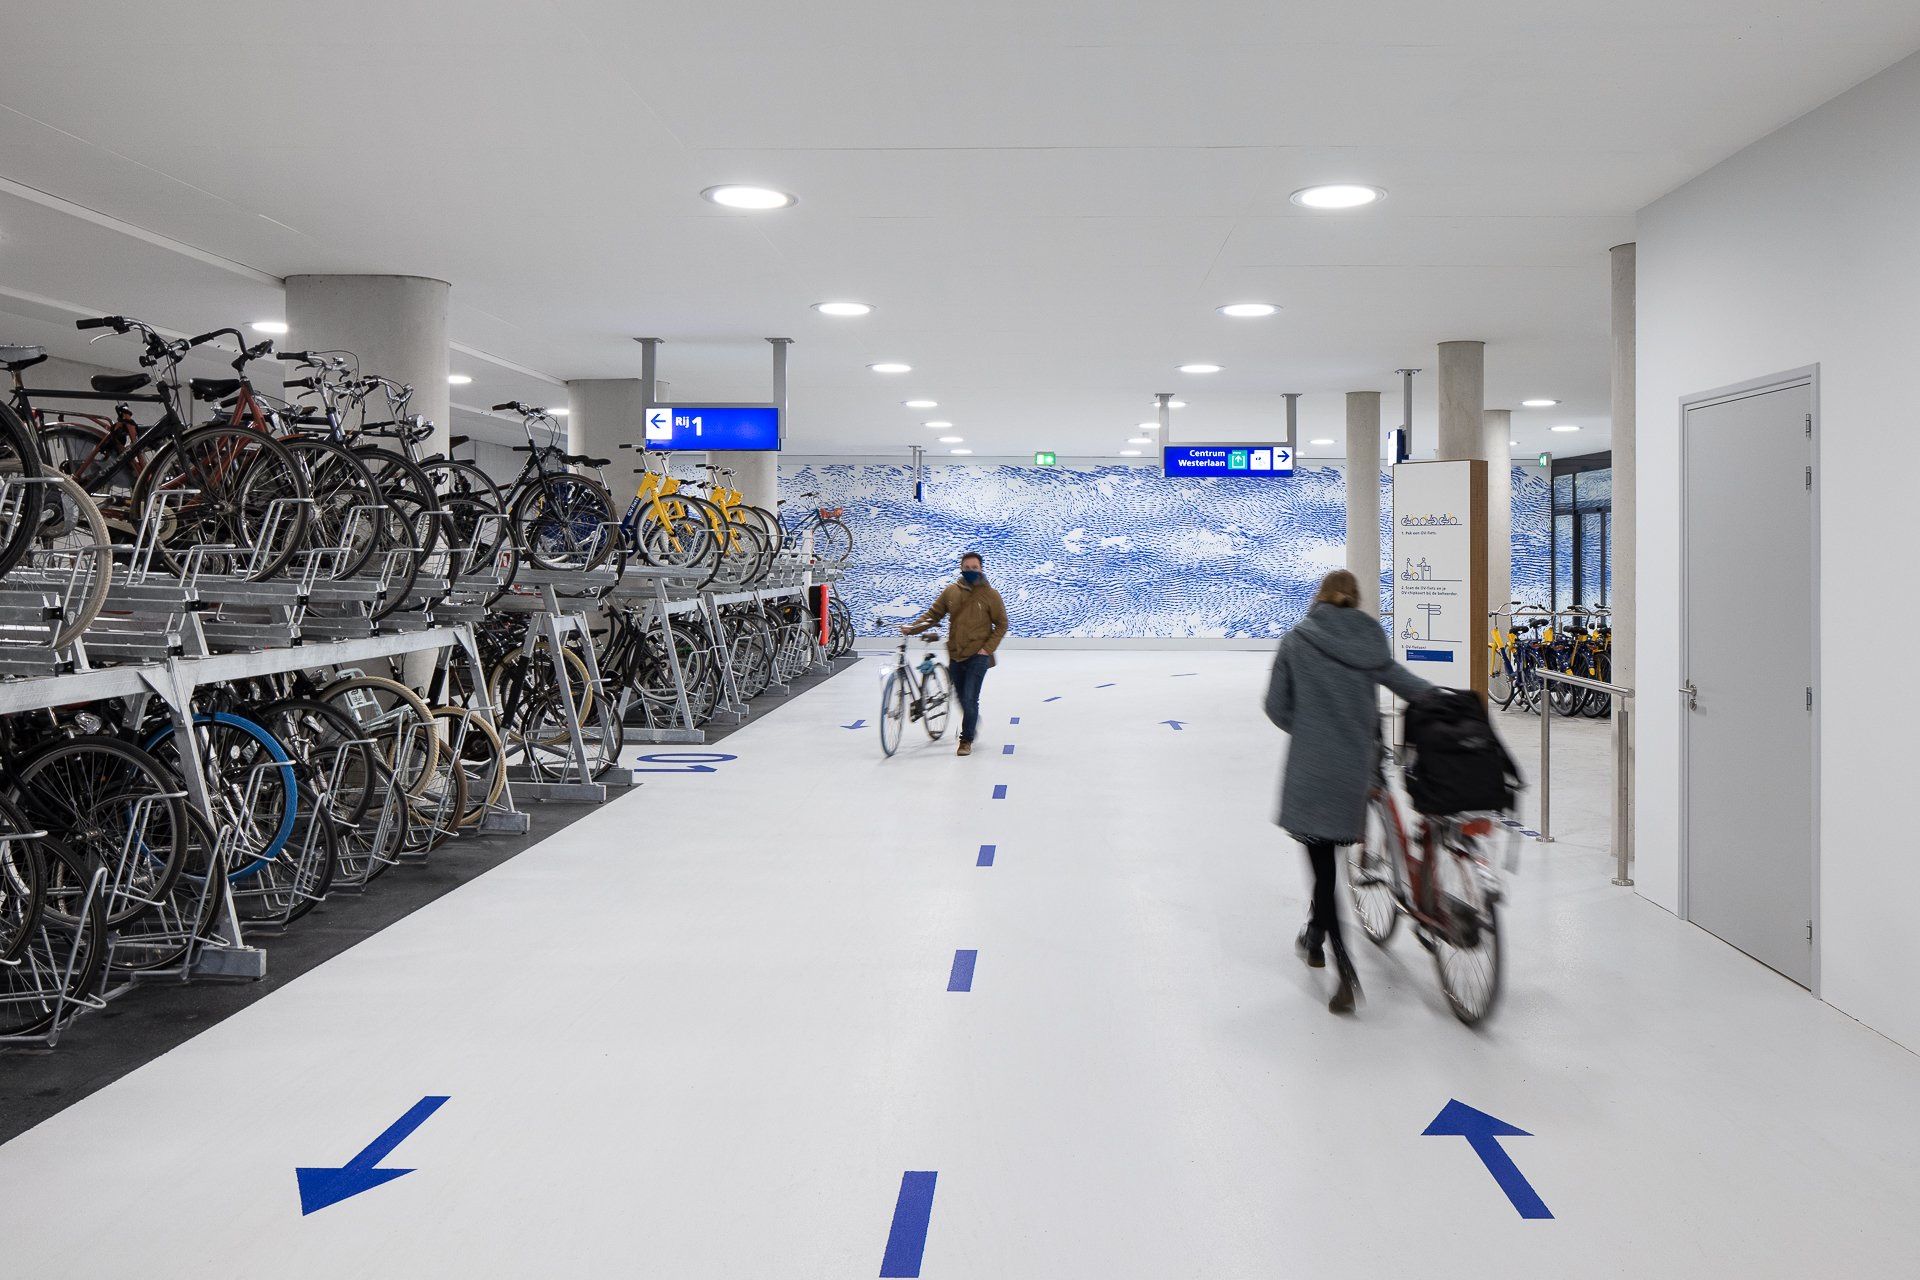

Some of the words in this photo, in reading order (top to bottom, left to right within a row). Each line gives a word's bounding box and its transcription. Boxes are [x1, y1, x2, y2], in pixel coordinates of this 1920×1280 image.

[675, 416, 690, 428] Rij
[692, 416, 703, 436] 1
[1178, 459, 1226, 467] Westerlaan
